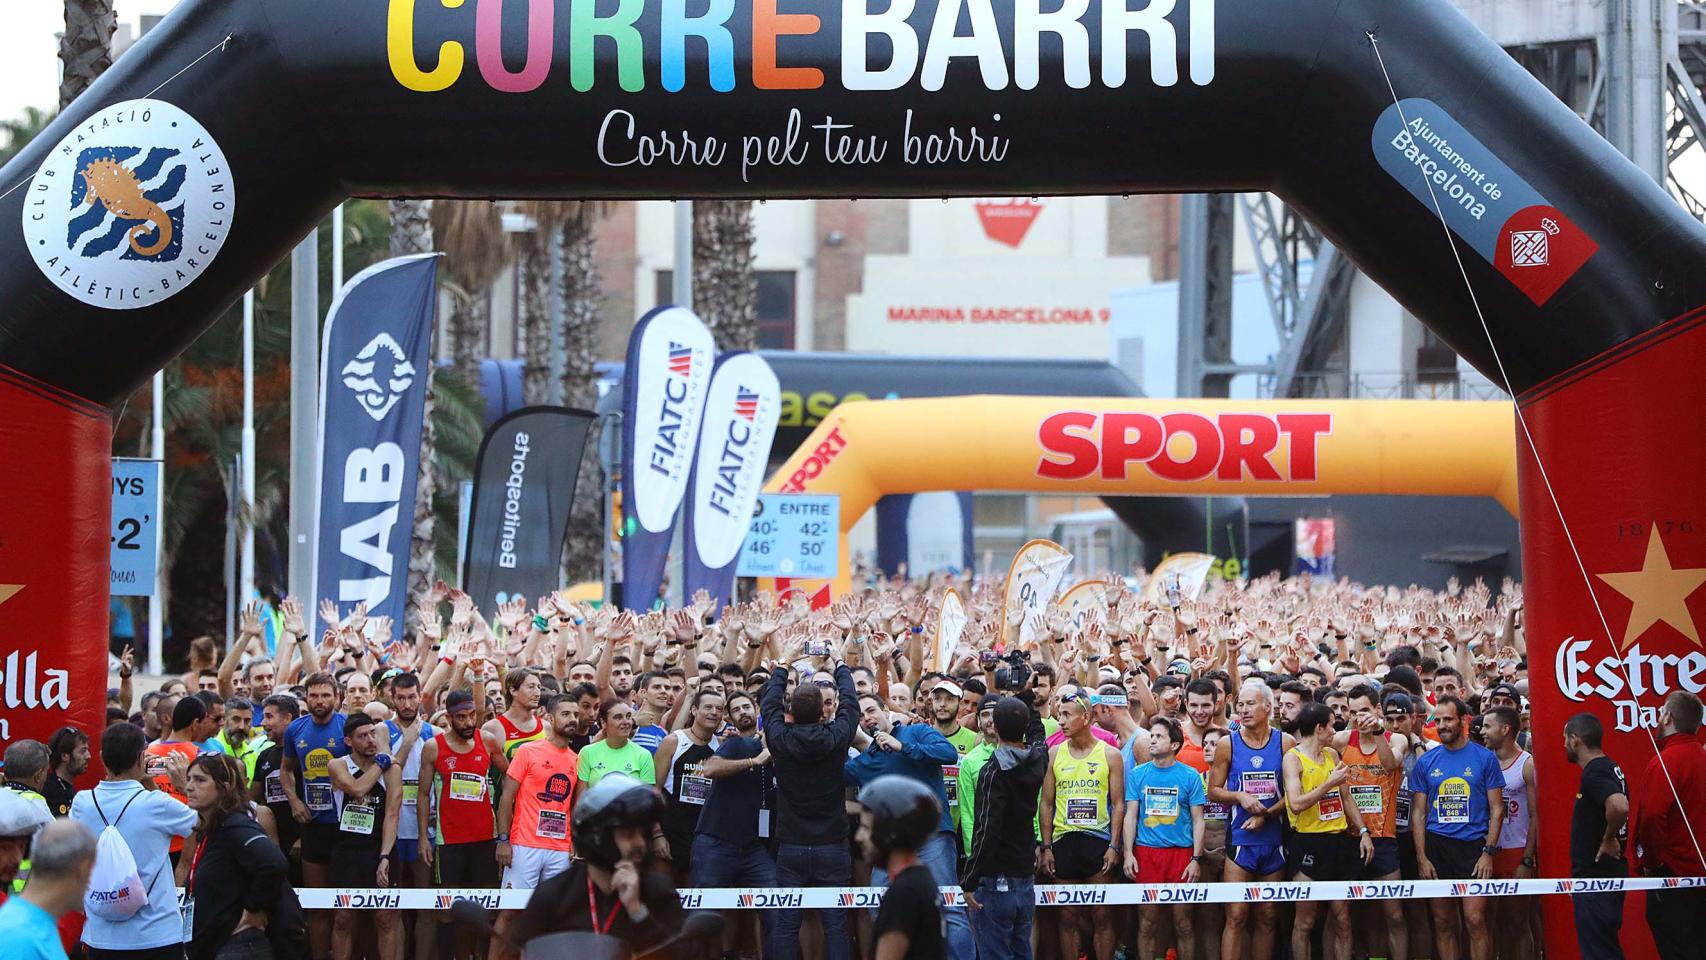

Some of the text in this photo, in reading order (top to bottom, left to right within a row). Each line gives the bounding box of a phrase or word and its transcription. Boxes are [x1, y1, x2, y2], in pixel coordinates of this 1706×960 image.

[597, 107, 1010, 183] Corre pel teu barri
[1408, 116, 1502, 201] Ajuntament de
[1391, 129, 1487, 220] Barcelona
[32, 169, 56, 221] CLUB
[887, 306, 965, 323] MARINA
[970, 306, 1094, 324] BARCELONA
[650, 377, 688, 477] FIATC
[1037, 411, 1334, 482] SPORT
[709, 419, 751, 517] FIATC
[112, 476, 145, 496] YS
[780, 503, 831, 516] ENTRE
[1554, 635, 1706, 702] Estre
[1262, 886, 1311, 900] FIATC
[1366, 884, 1415, 898] FIATC
[1469, 881, 1519, 895] FIATC
[1575, 879, 1625, 892] FIATC
[351, 894, 401, 908] FIATC
[679, 894, 703, 908] FIA
[754, 894, 803, 907] FIATC
[1058, 890, 1106, 904] FIATC
[1160, 888, 1209, 902] FIATC
